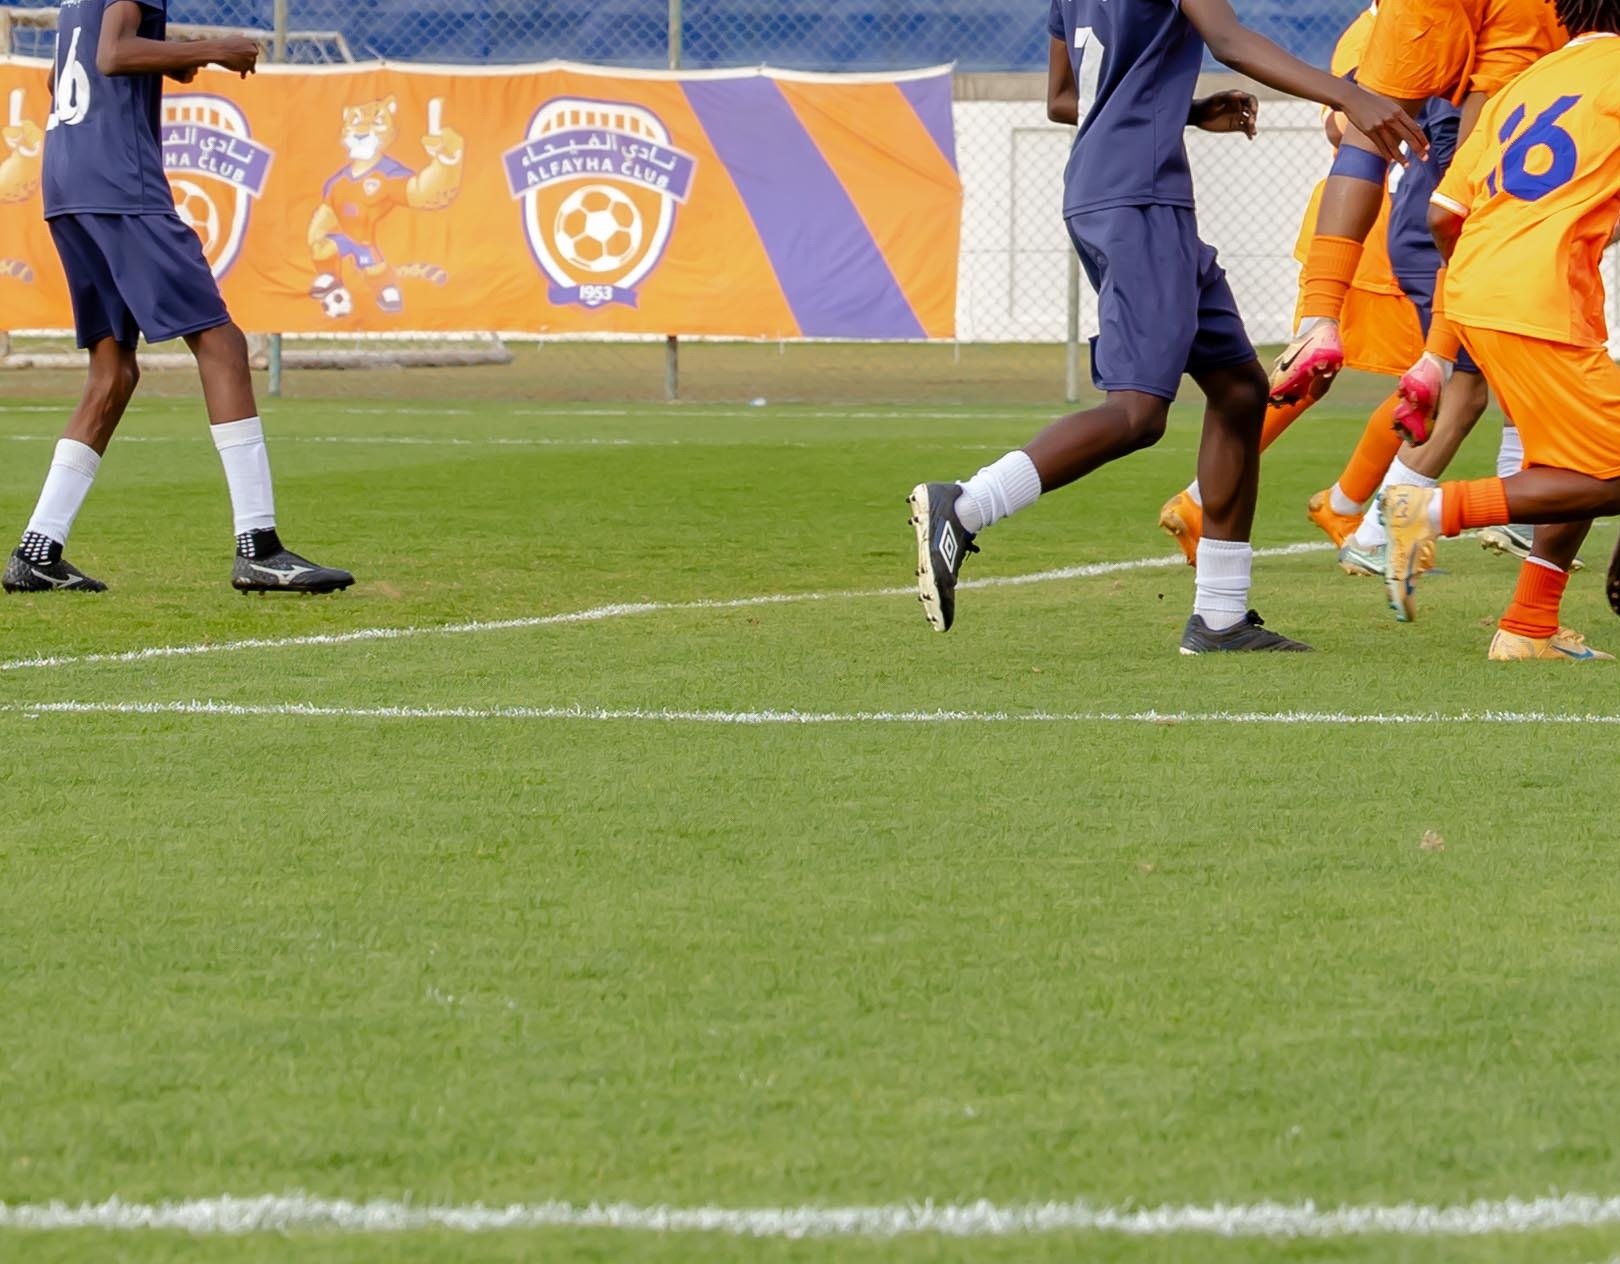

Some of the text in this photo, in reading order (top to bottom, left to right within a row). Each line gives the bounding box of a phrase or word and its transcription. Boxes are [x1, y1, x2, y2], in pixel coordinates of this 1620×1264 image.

[521, 133, 678, 172] نادي الفيحاء
[198, 156, 246, 183] CLUB
[526, 157, 670, 188] ALFAYHA CLUB
